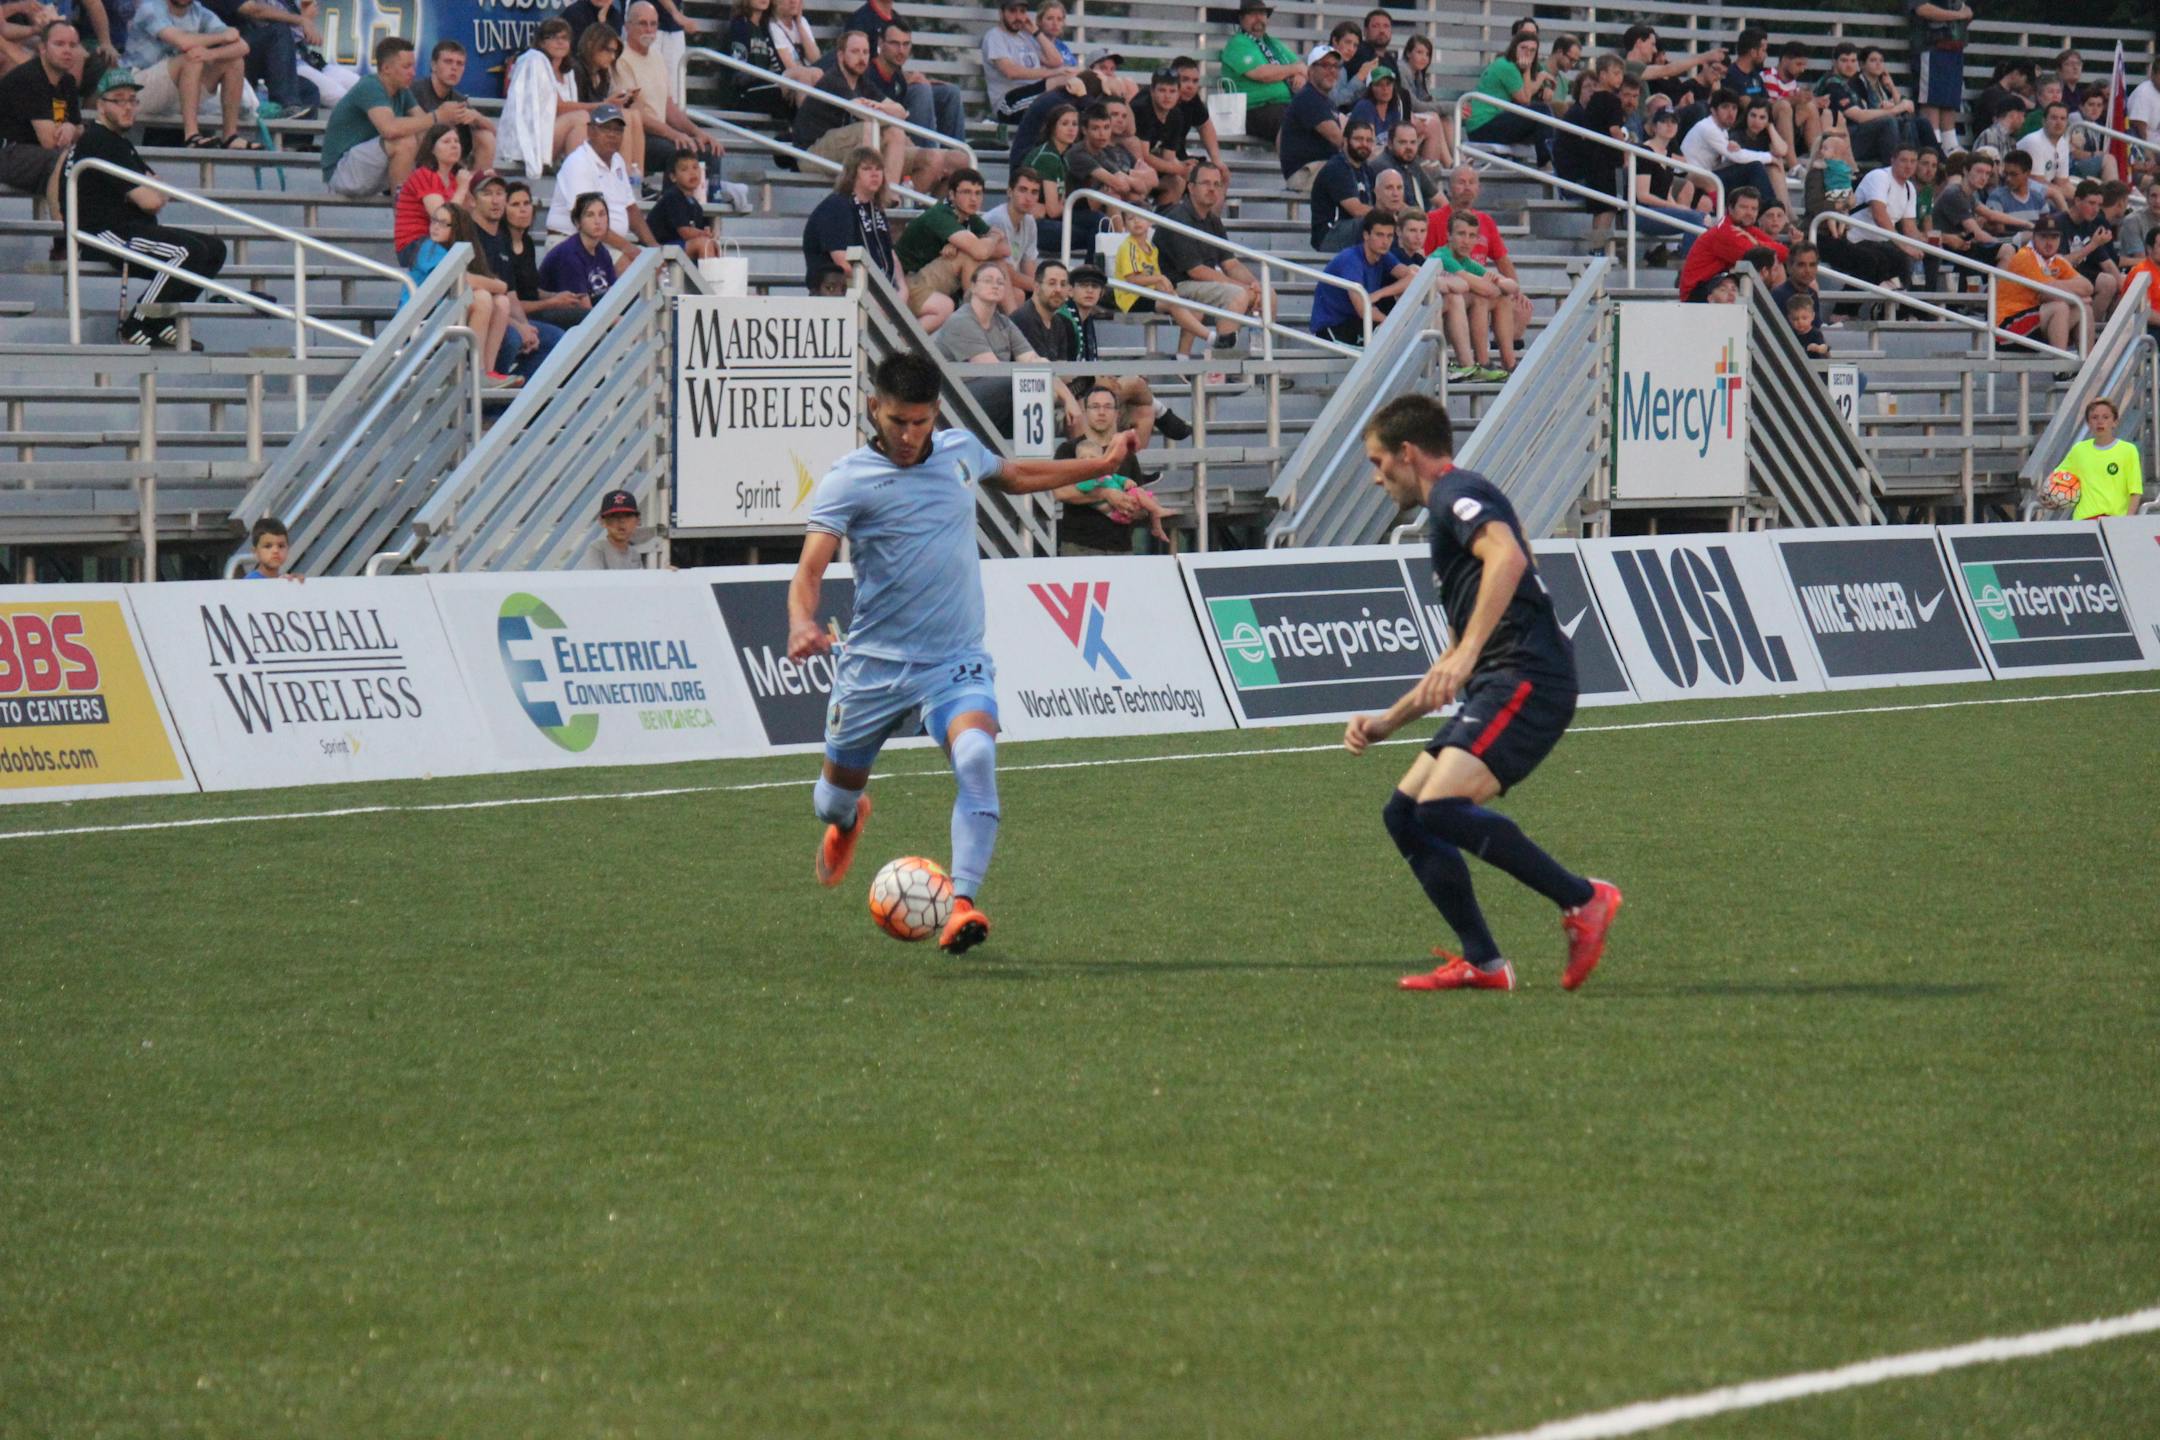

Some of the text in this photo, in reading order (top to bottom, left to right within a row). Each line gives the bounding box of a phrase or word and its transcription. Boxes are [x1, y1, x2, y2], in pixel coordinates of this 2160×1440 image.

[473, 19, 541, 54] UNIVE
[685, 309, 852, 370] MARSHALL
[1019, 378, 1046, 393] SECTION
[685, 377, 852, 438] WIRELESS
[1023, 402, 1044, 445] 13
[1622, 371, 1717, 458] Mercy
[736, 481, 781, 517] Sprint
[1611, 546, 1798, 689] USL
[1800, 582, 1917, 634] NIKE SOCCER
[1976, 574, 2119, 626] enterprise
[200, 604, 399, 667] MARSHALL
[552, 636, 698, 673] ELECTRICAL
[1221, 607, 1420, 667] enterprise
[27, 698, 103, 722] CENTERS
[214, 671, 423, 735] WIRELESS
[564, 680, 706, 706] CONNECTION.ORG
[1018, 684, 1206, 718] World Wide Technology
[0, 745, 99, 773] dobbs.com
[320, 738, 350, 758] Sprint
